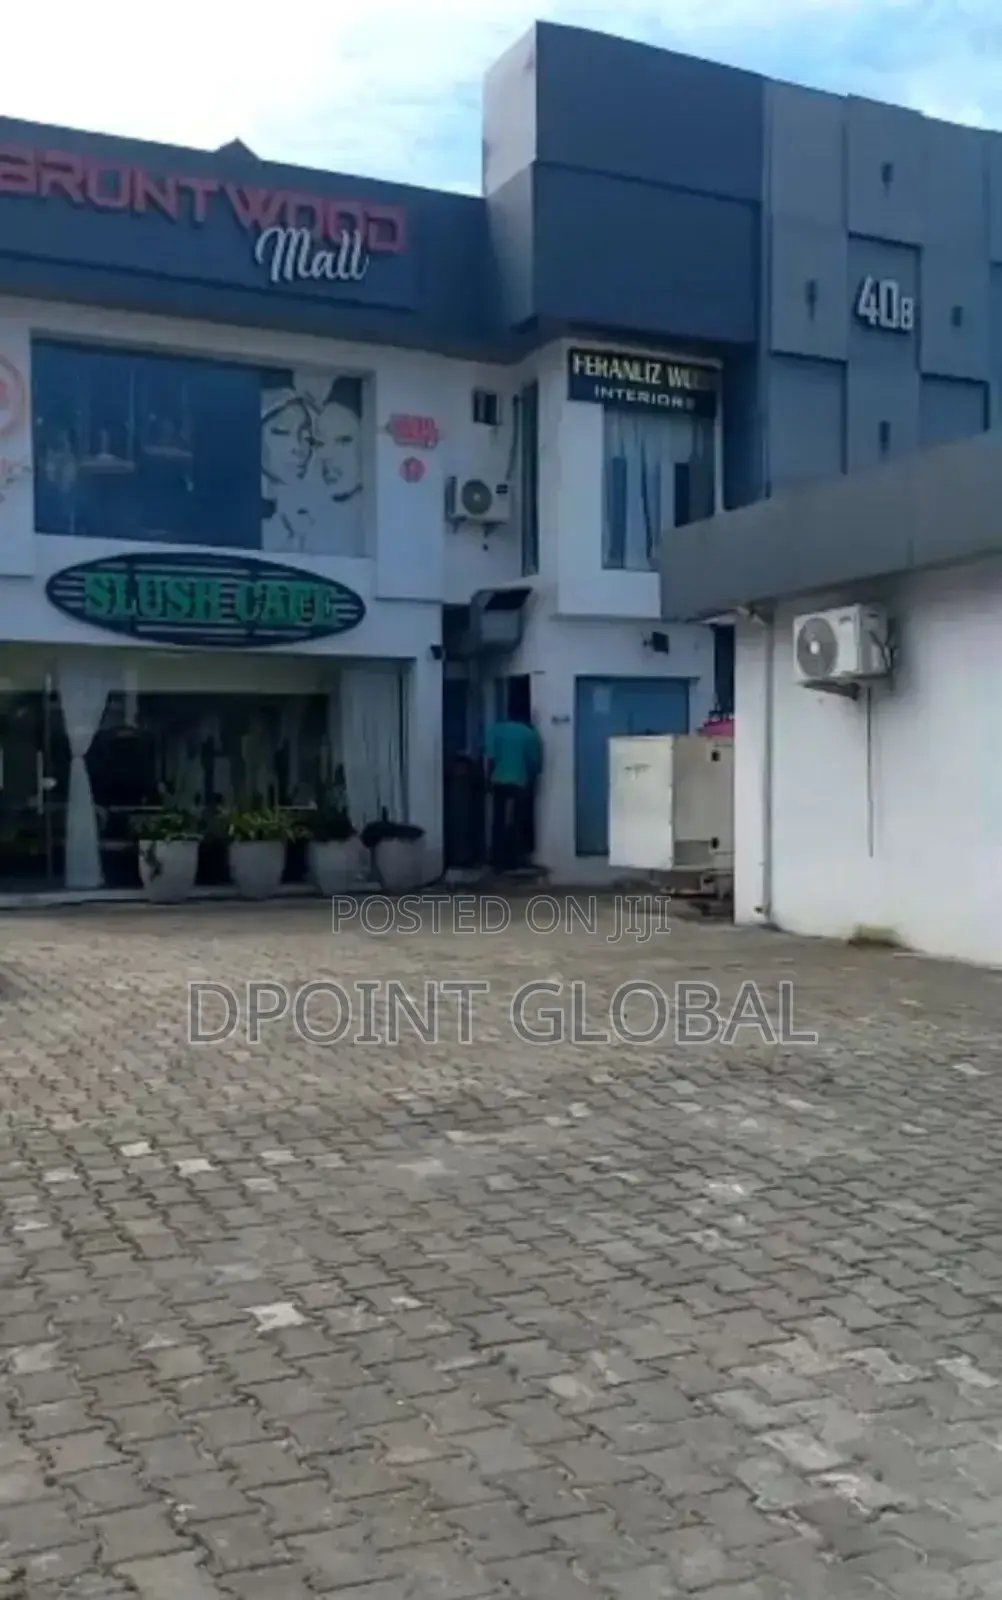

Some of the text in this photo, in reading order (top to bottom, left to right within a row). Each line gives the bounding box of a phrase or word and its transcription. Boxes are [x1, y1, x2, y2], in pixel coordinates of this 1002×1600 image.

[255, 226, 370, 283] Mall
[857, 274, 914, 330] 40B
[84, 571, 337, 627] SLUSH CAFE
